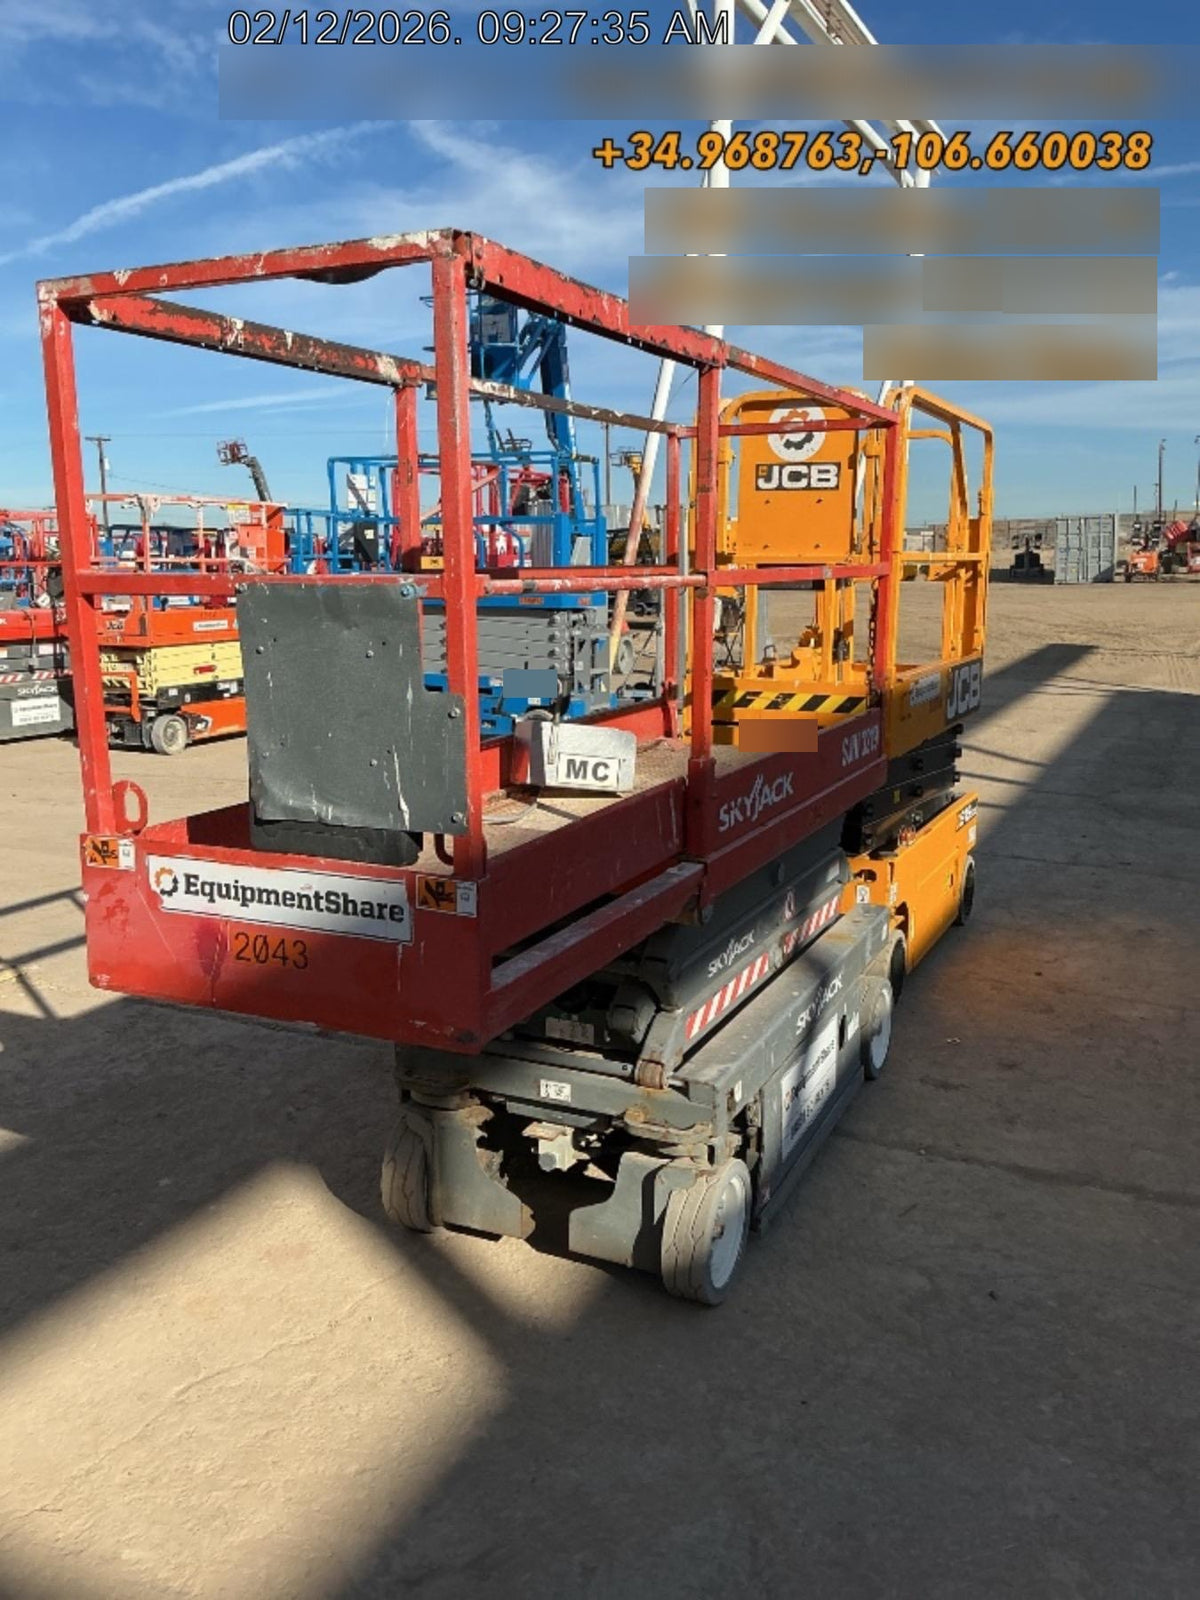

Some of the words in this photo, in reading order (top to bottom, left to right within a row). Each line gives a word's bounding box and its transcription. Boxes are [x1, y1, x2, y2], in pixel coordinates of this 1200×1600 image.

[757, 463, 840, 490] JCB
[946, 662, 981, 720] JCB
[565, 758, 610, 782] MC
[718, 773, 794, 832] SKYJACK
[183, 873, 405, 924] EquipmentShare
[234, 932, 308, 969] 2043
[707, 929, 755, 978] SKYJACK
